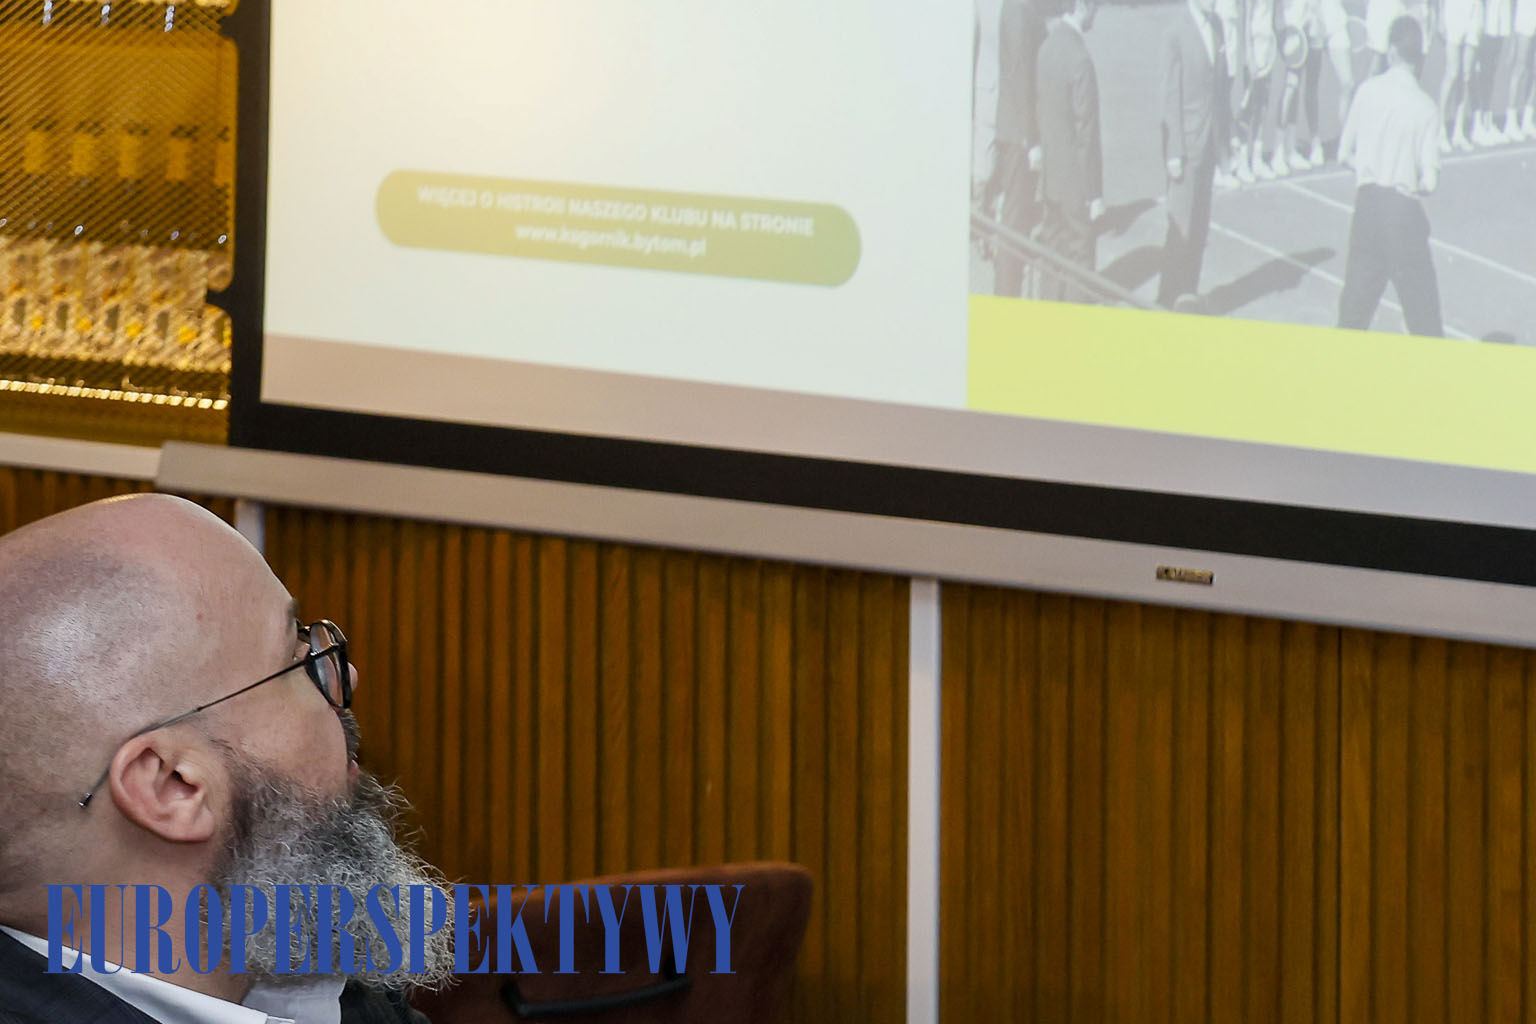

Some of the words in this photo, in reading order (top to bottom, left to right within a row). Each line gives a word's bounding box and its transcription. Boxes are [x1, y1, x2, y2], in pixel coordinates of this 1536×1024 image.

[480, 188, 494, 209] O
[569, 198, 647, 221] NASZEGO
[650, 204, 708, 227] KLUBU
[712, 209, 737, 230] NA
[740, 211, 815, 237] STRONIE
